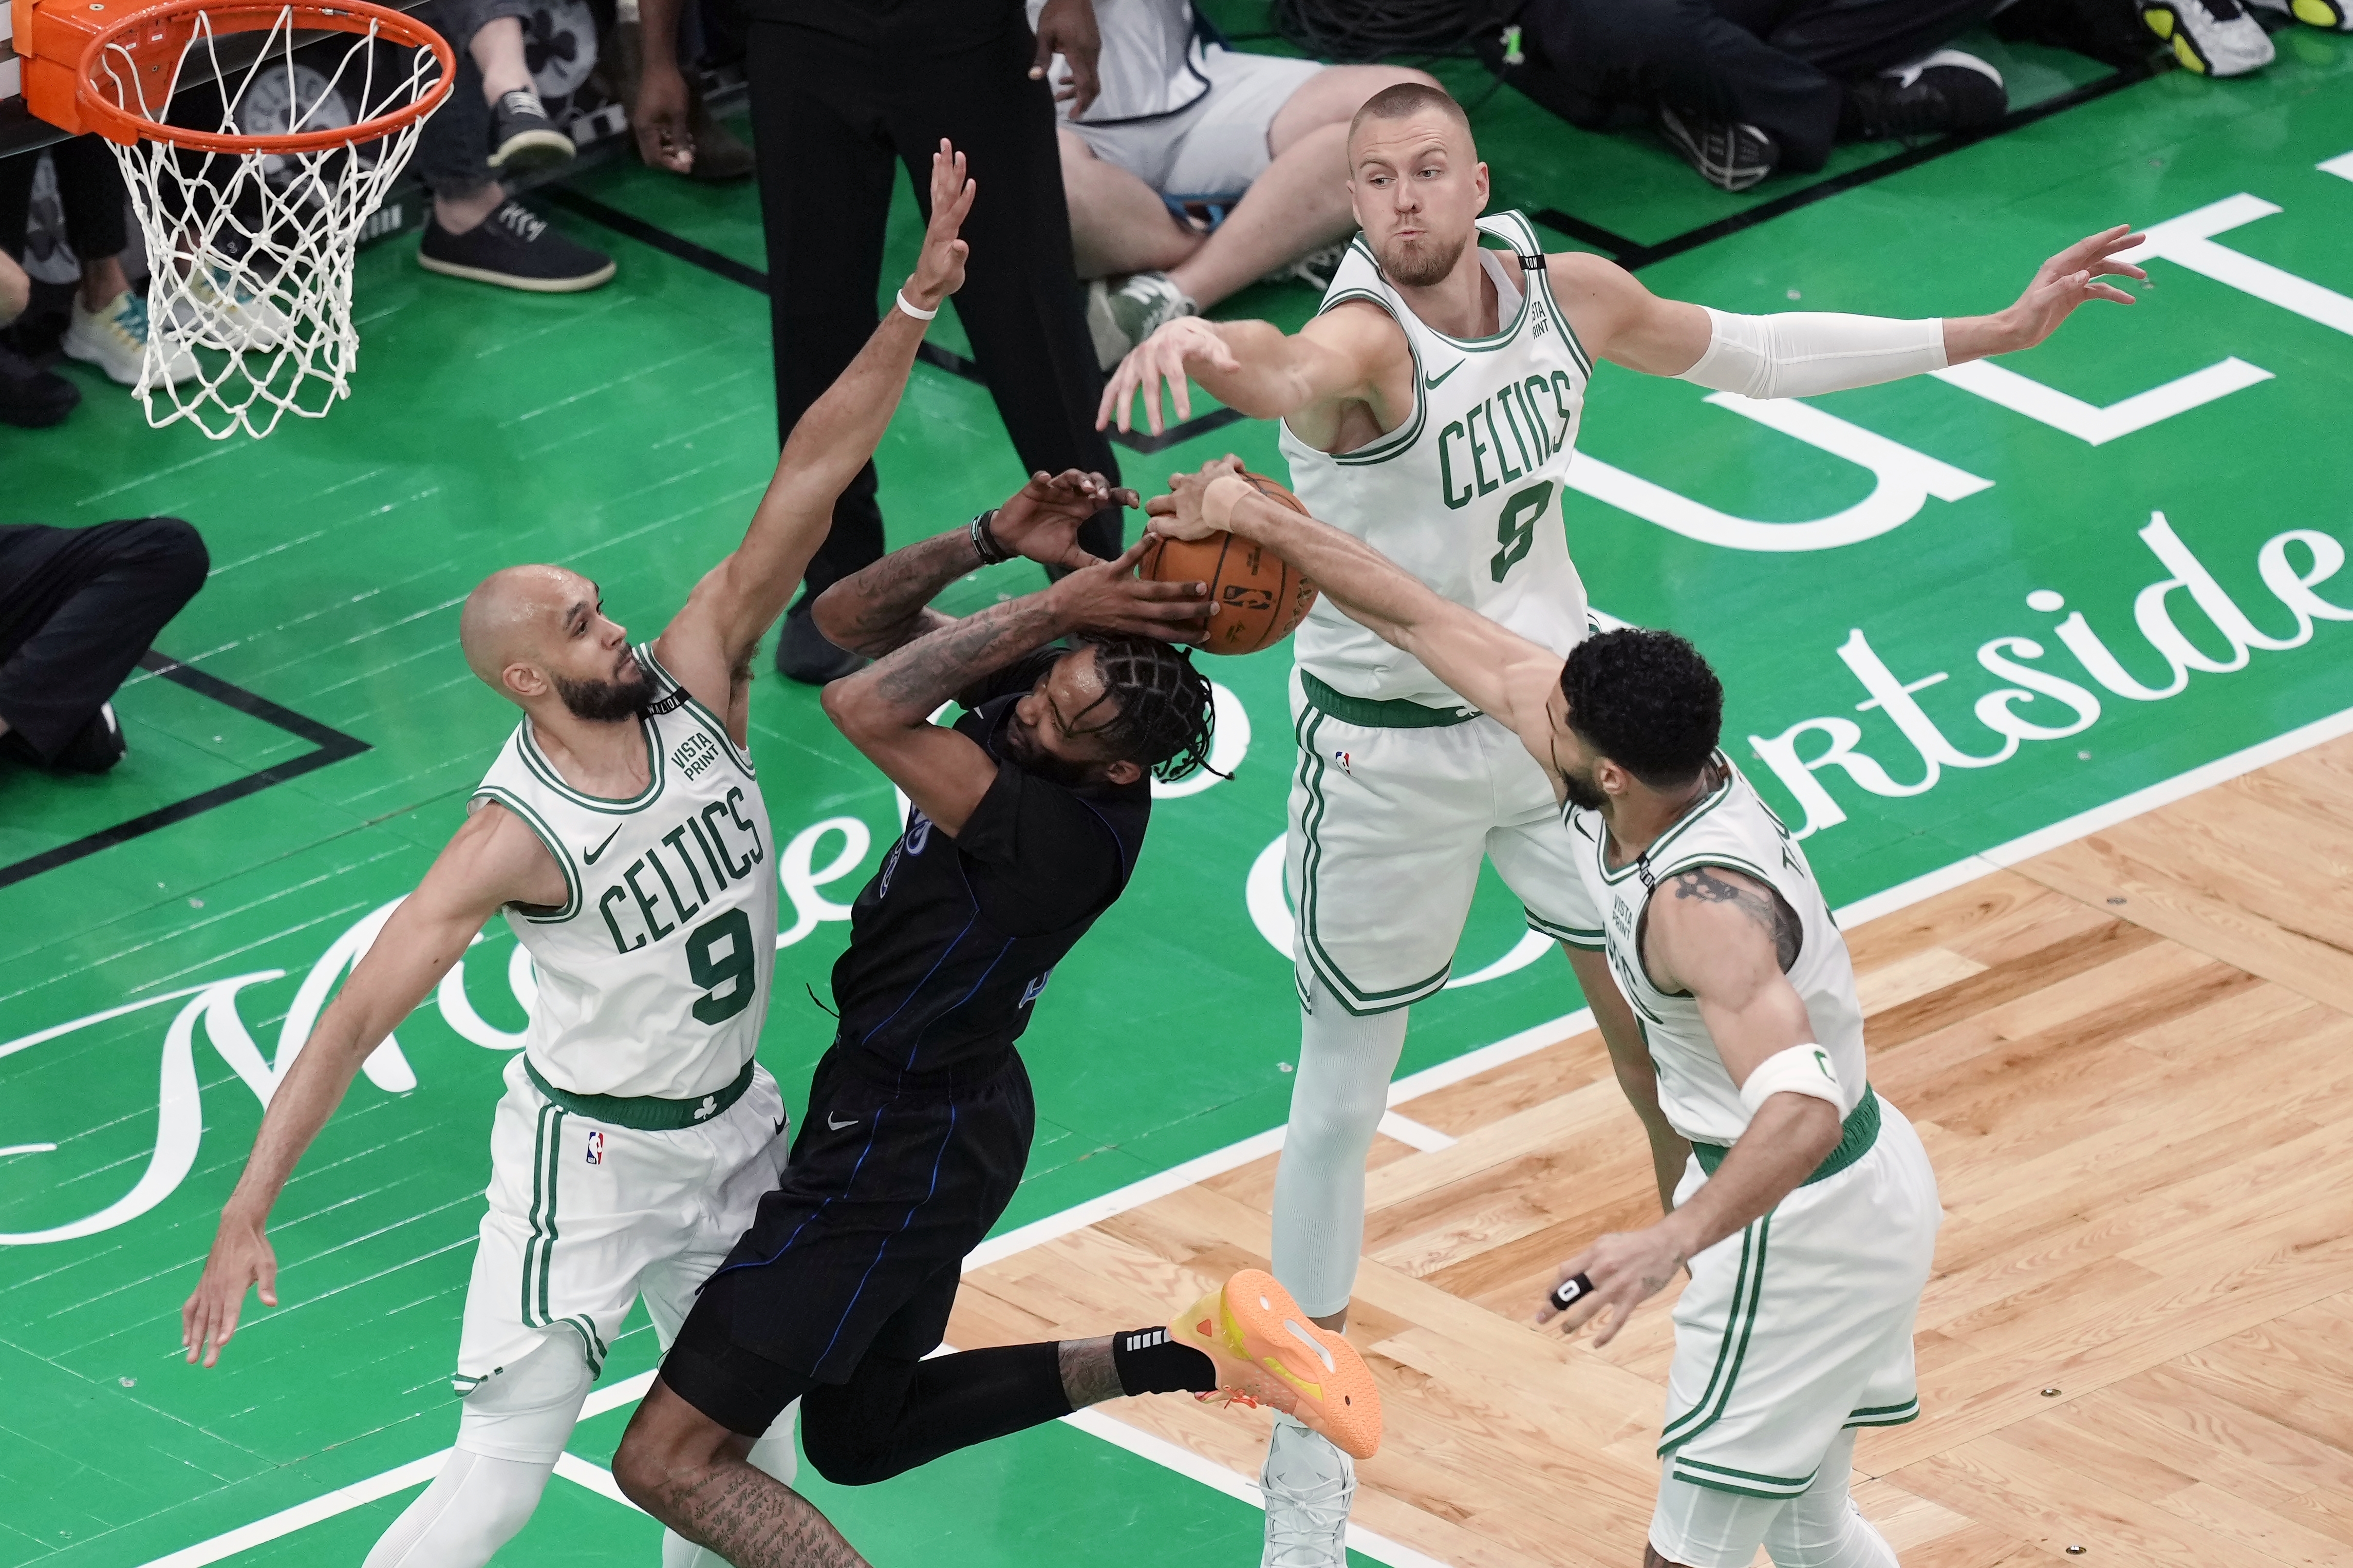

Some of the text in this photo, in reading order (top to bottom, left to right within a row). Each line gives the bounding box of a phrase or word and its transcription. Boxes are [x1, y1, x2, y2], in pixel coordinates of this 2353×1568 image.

[1531, 301, 1546, 323] STA
[1533, 318, 1549, 340] RINT
[1565, 153, 2353, 552] ULT
[1438, 370, 1570, 509] CELTICS
[646, 695, 680, 715] WALTON
[671, 732, 712, 769] VISTA
[684, 744, 719, 781] PRINT
[599, 786, 763, 954] CELTICS
[1612, 910, 1630, 941] PRINT
[1614, 893, 1633, 929] VISTA
[685, 908, 756, 1026] 9
[1557, 1279, 1580, 1302] 0
